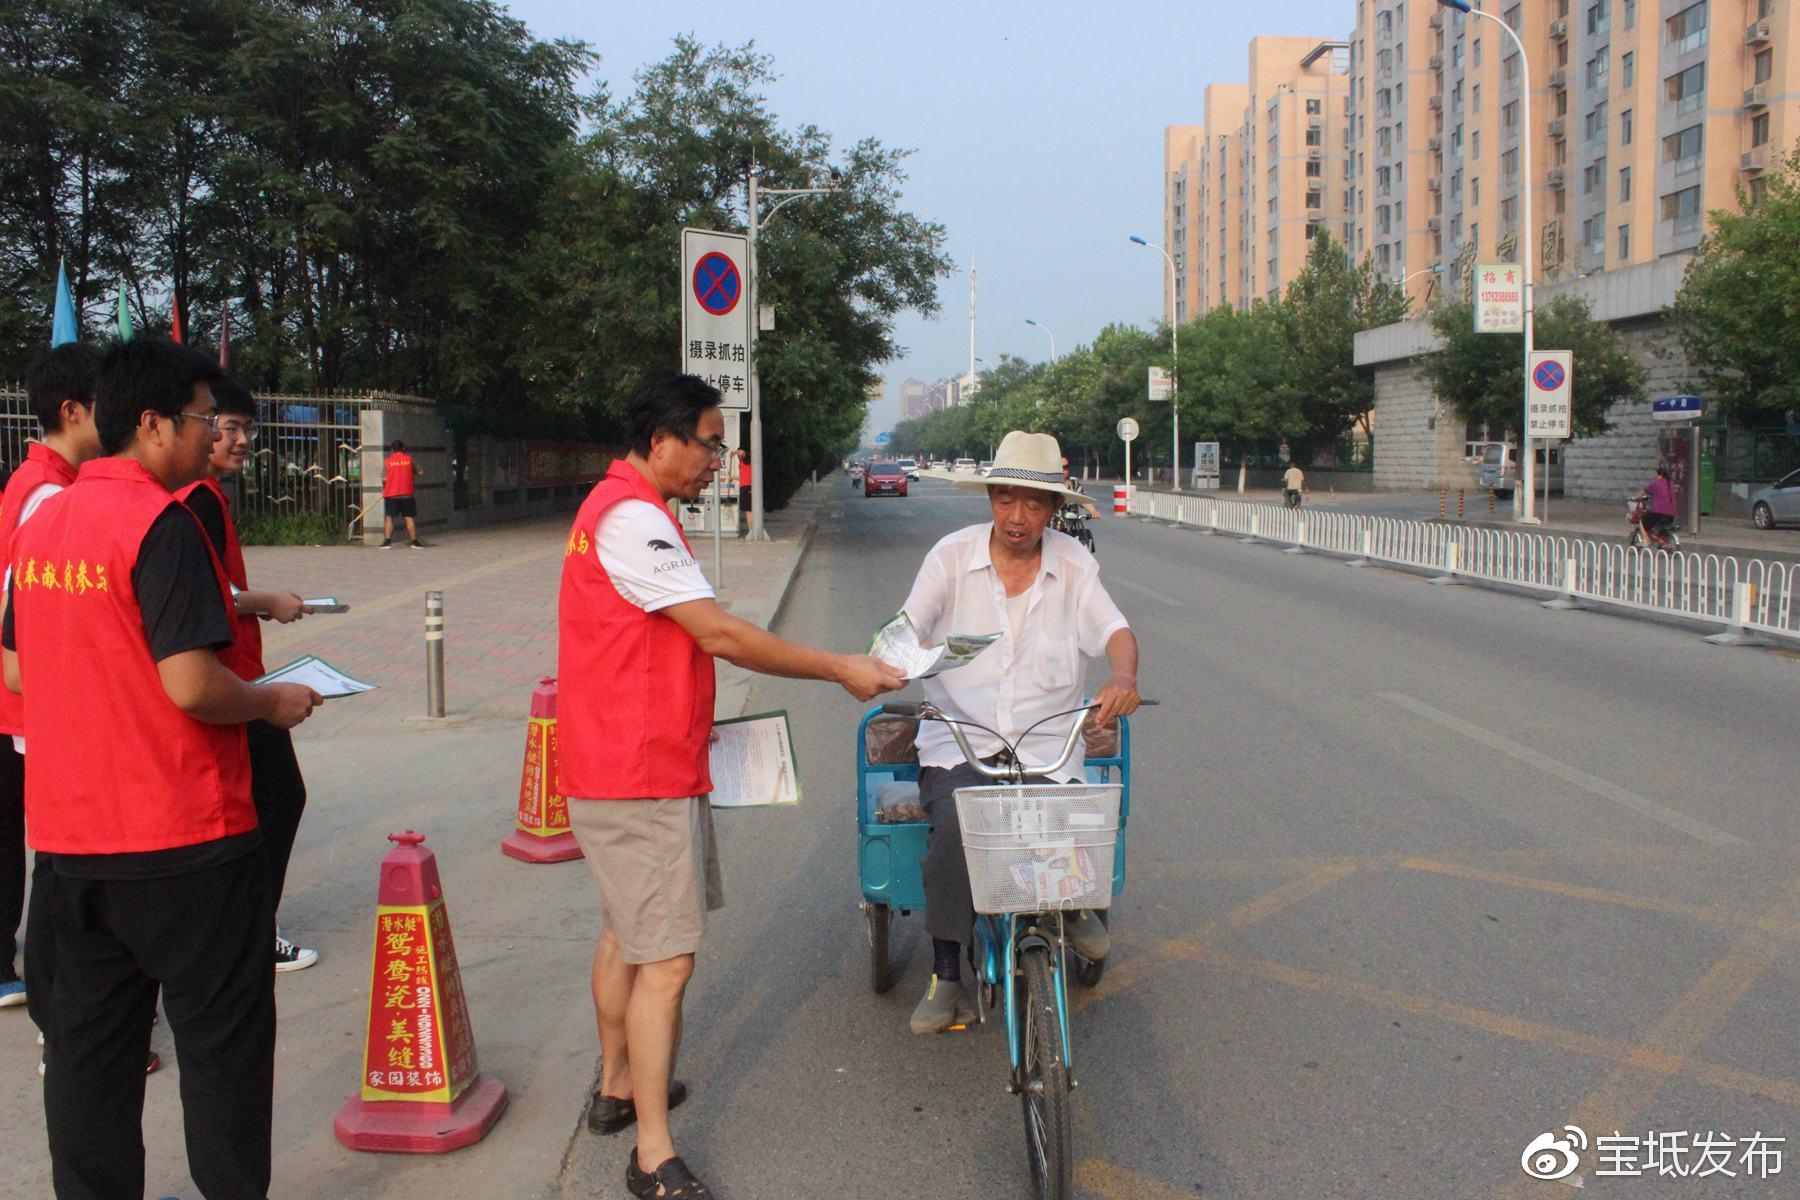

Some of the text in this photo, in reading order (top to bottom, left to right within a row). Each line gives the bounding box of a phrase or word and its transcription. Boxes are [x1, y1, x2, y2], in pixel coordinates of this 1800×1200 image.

[690, 340, 745, 362] 摄录抓拍
[688, 373, 745, 393] 止停车
[1530, 403, 1567, 414] 摄录抓拍
[1530, 420, 1566, 430] 禁止停车
[382, 915, 417, 932] 潜水艇
[368, 1070, 443, 1088] 家园装饰
